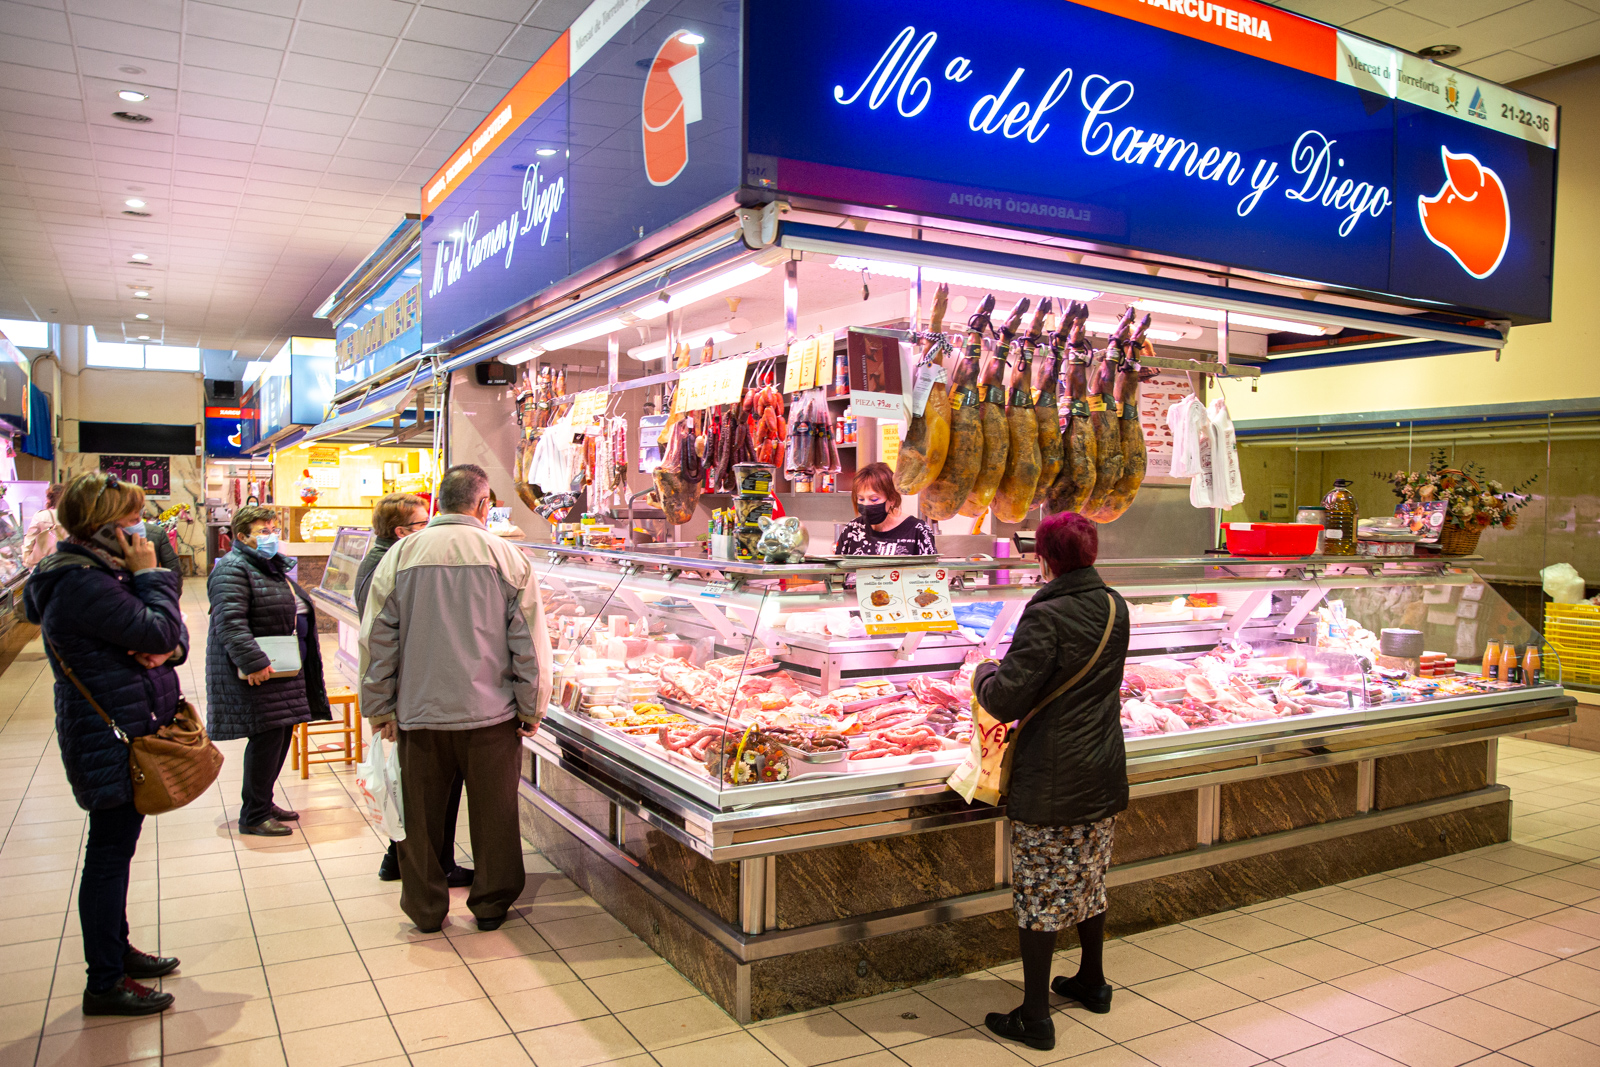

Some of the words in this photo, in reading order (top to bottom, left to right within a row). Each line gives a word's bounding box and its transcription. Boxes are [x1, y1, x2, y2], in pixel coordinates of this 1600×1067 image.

[1347, 54, 1381, 77] Mercat
[1397, 68, 1441, 95] Torreforta
[1501, 102, 1550, 132] 21-22-36
[968, 67, 1073, 144] del
[1080, 73, 1245, 187] Carmen
[1250, 158, 1280, 218] y
[1285, 129, 1393, 238] Diego
[466, 210, 509, 273] Carmen
[520, 161, 566, 248] Diego
[855, 399, 875, 407] PIEZA
[152, 473, 159, 486] 0
